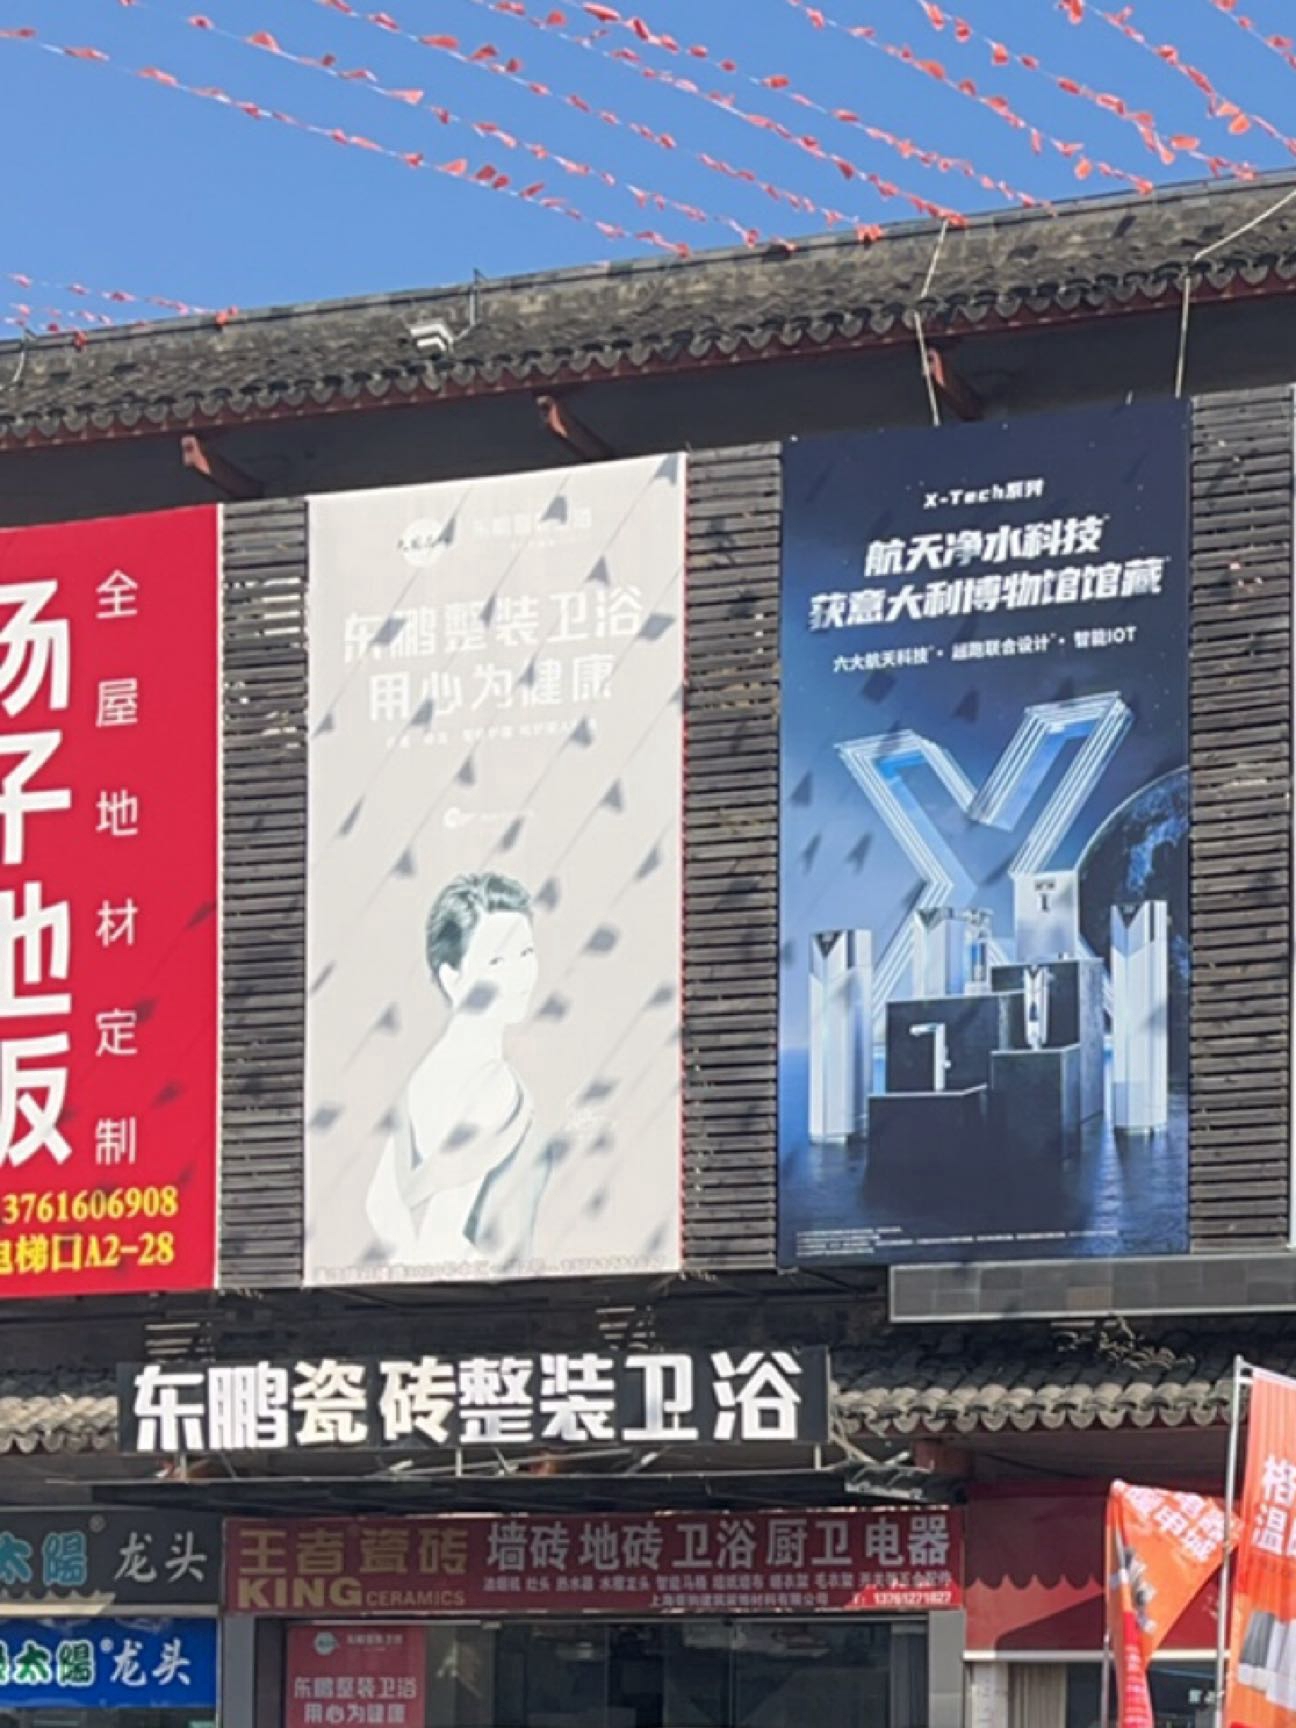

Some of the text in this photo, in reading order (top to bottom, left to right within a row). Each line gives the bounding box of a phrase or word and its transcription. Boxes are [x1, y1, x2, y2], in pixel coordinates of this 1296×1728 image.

[864, 516, 1105, 578] 航天净水科技
[808, 557, 1168, 632] 获意大利博物馆馆藏
[94, 570, 140, 1166] 全屋地材定制
[134, 1350, 803, 1451] 东鹏瓷砖整装卫浴
[237, 1577, 365, 1610] KING
[110, 1637, 191, 1687] 龙头
